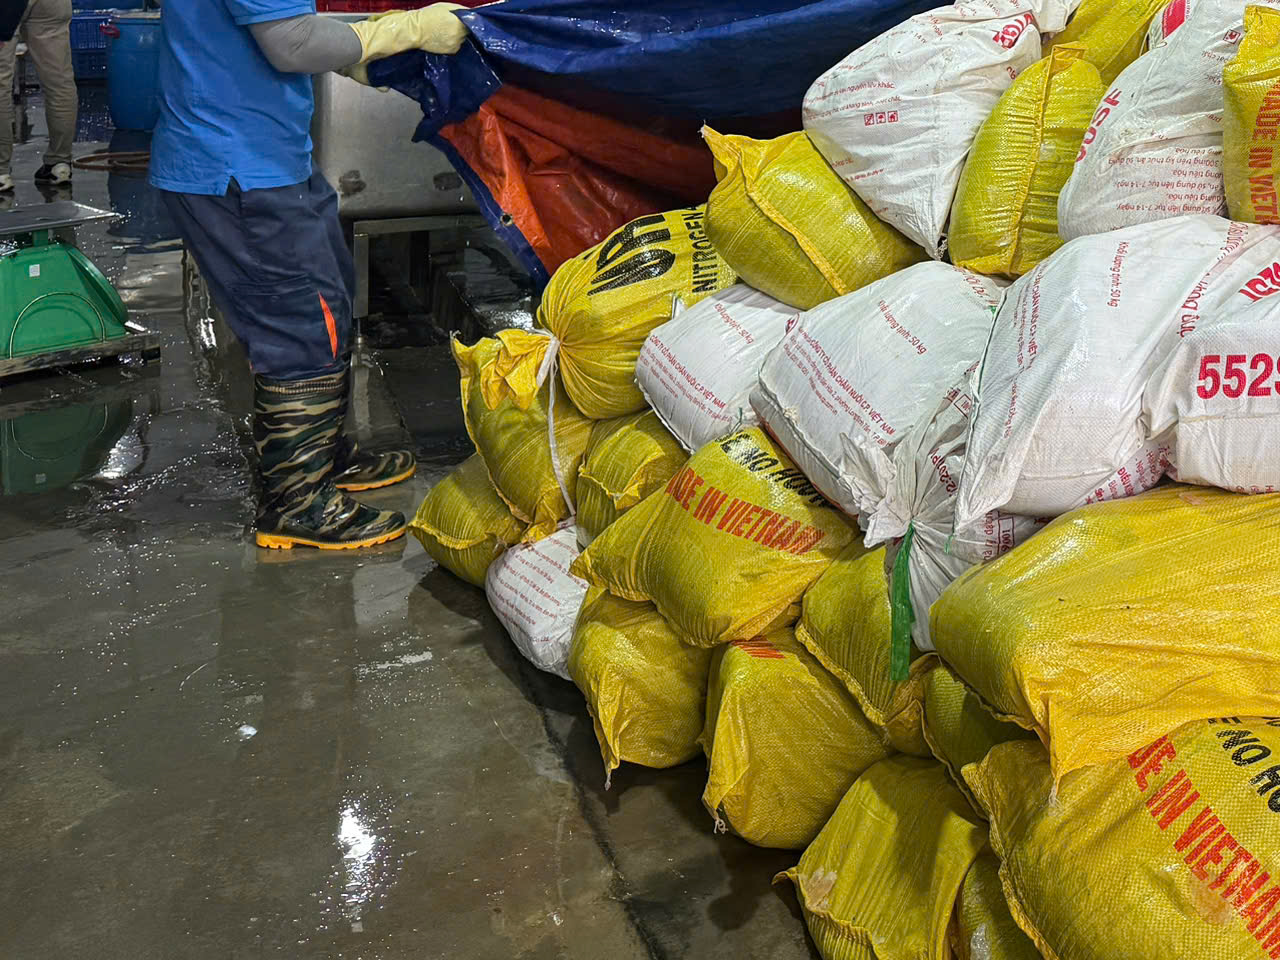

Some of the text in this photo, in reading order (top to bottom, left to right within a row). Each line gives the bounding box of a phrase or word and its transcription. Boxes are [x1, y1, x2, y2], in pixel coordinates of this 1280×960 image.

[1248, 146, 1273, 168] IN
[693, 486, 728, 525] IN
[716, 497, 825, 556] VIETNAM
[1216, 728, 1271, 782] NO
[1146, 770, 1201, 830] IN
